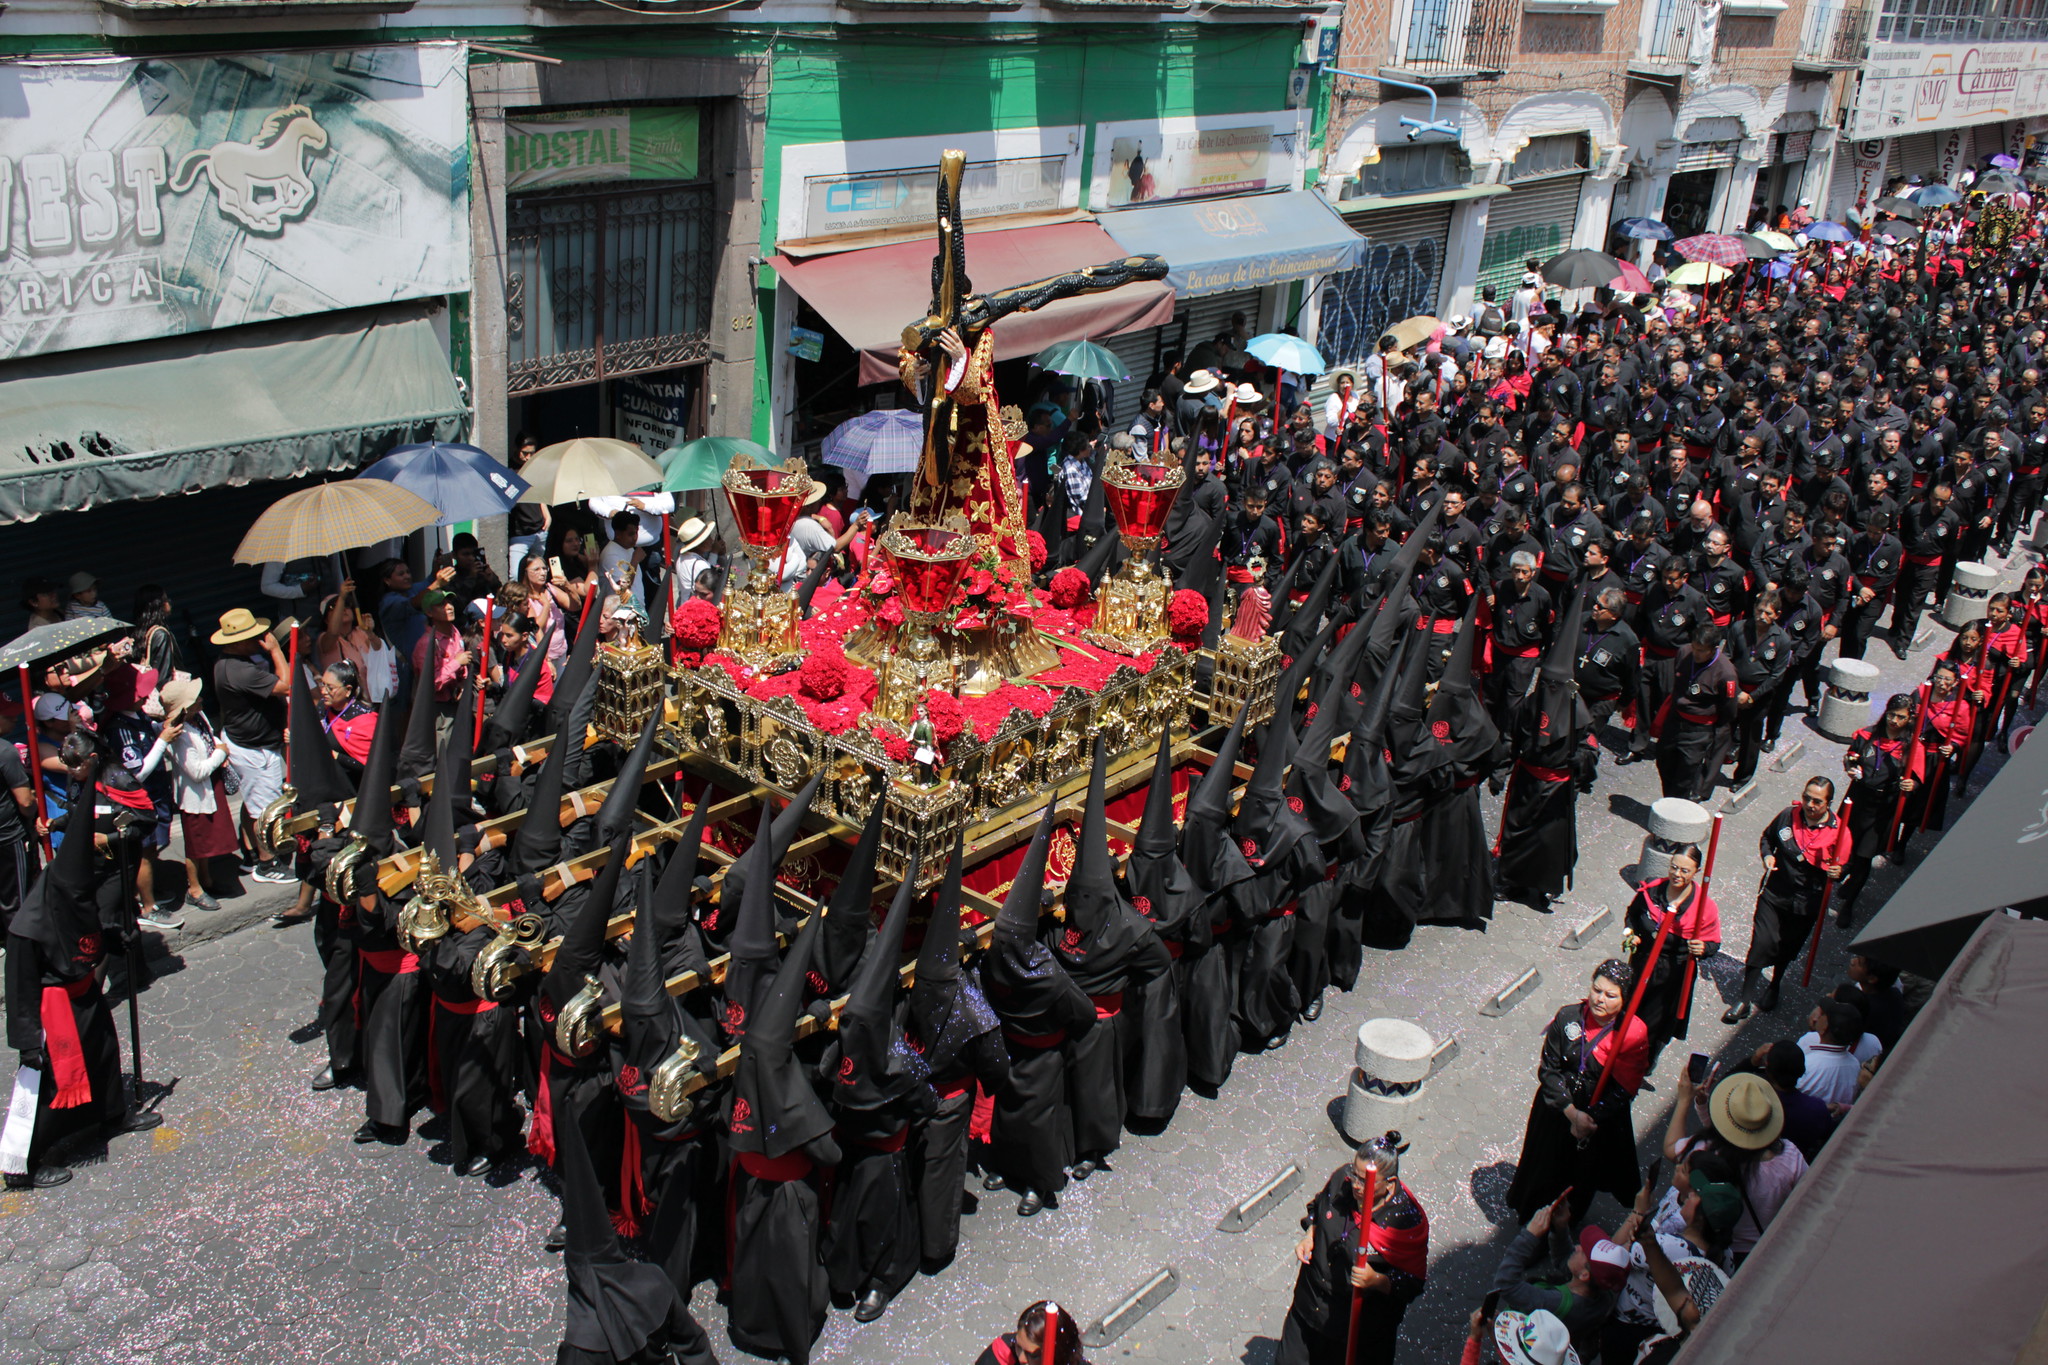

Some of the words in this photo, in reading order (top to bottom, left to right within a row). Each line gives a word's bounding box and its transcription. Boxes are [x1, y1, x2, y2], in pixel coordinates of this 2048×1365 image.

[1958, 48, 2018, 94] Carmen
[505, 127, 627, 173] HOSTAL
[1940, 129, 1960, 185] ARMACIA
[0, 145, 167, 250] EST
[826, 180, 892, 212] CEL
[1859, 169, 1873, 201] CLIE
[1186, 270, 1202, 290] La
[1206, 272, 1230, 287] casa
[1233, 264, 1246, 283] de
[1250, 261, 1265, 280] las
[732, 314, 753, 332] 312
[622, 393, 680, 422] CUARTOS
[629, 432, 645, 445] AL
